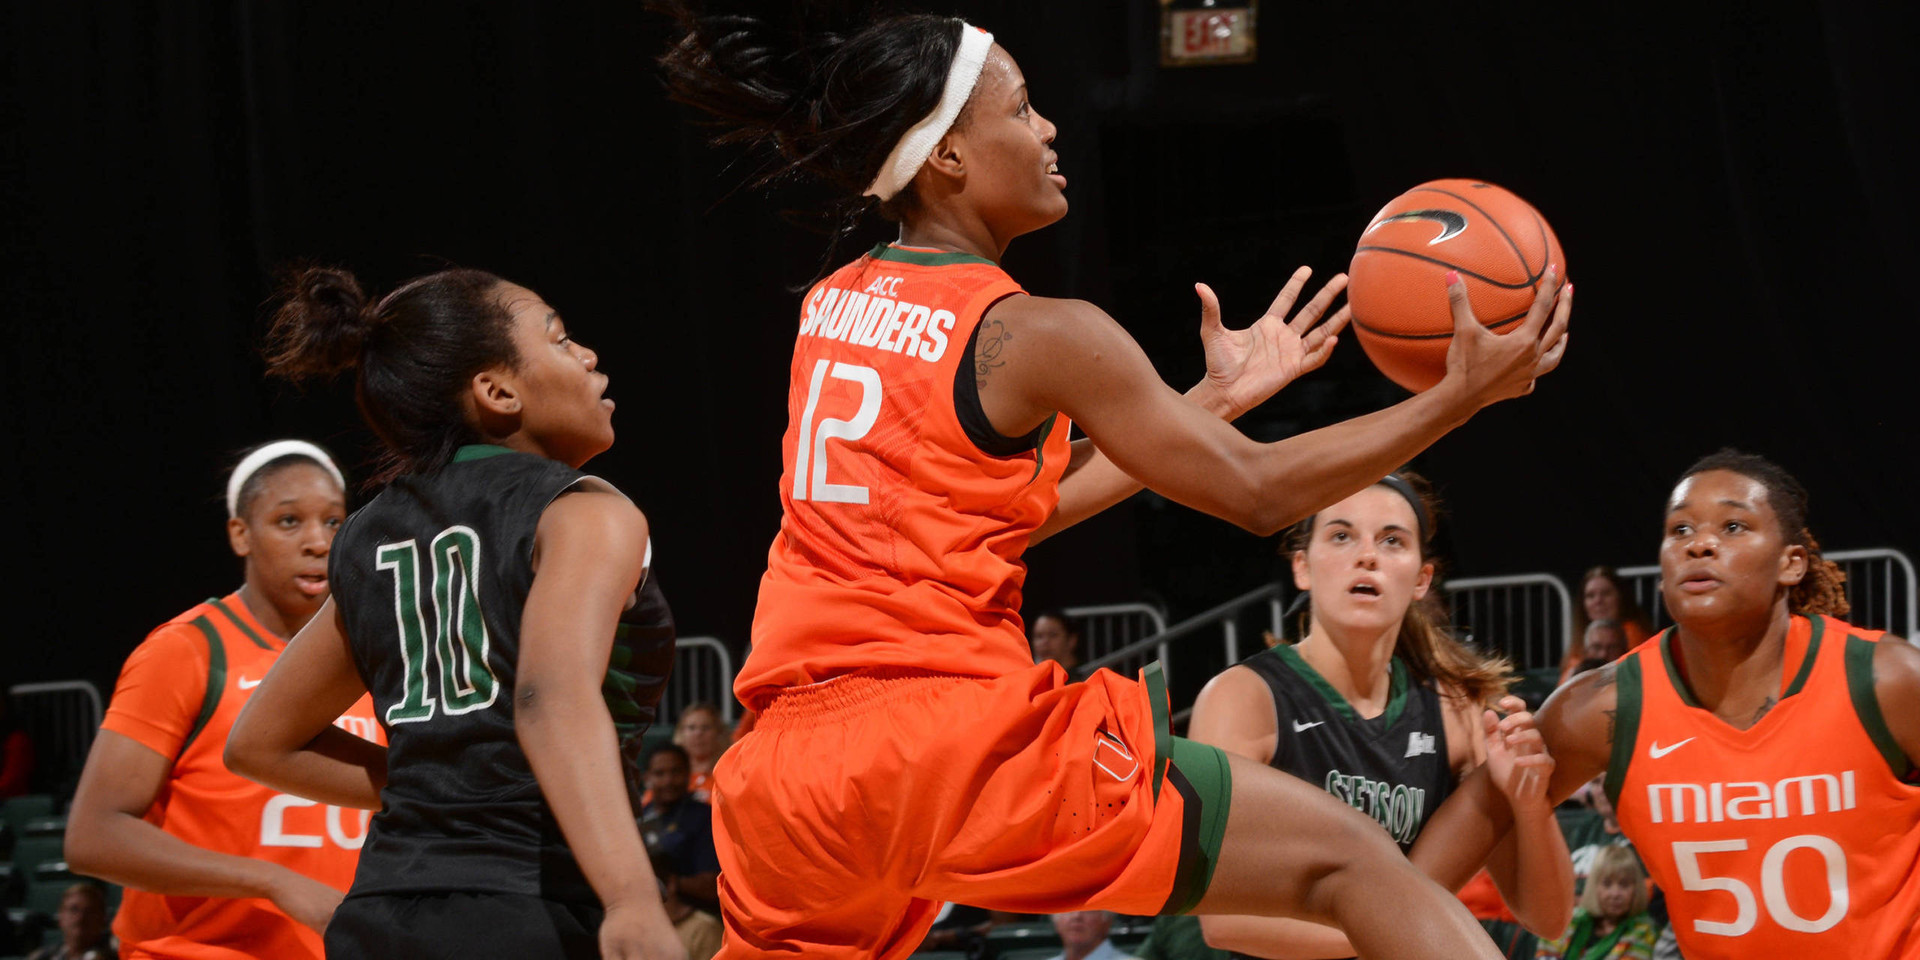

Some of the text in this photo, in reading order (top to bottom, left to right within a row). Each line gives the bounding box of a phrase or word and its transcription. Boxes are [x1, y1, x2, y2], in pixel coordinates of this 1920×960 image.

[800, 286, 956, 363] SAUNDERS
[864, 276, 904, 297] ACC
[792, 359, 883, 505] 12
[375, 525, 499, 726] 10
[260, 794, 370, 850] 20
[1646, 770, 1857, 824] MIAMI
[1671, 835, 1849, 938] 50
